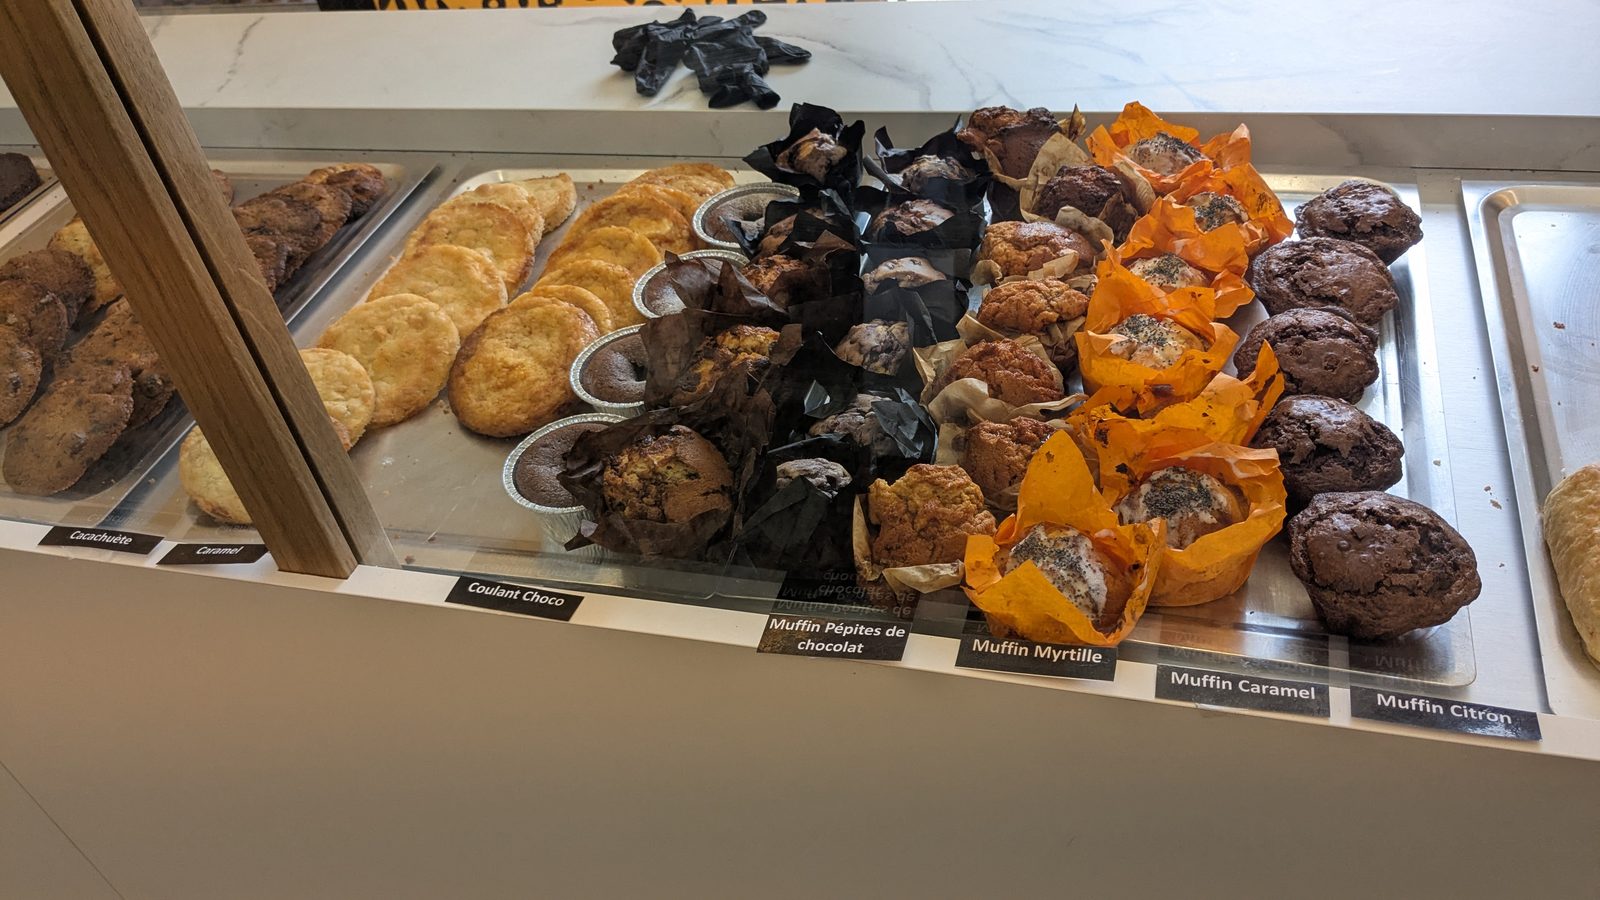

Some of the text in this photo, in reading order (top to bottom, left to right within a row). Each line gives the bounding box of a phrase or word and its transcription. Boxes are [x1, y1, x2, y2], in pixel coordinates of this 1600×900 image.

[69, 530, 133, 545] Cacachuète
[195, 545, 245, 555] Caramel
[467, 582, 565, 607] Coulant Choco
[769, 618, 906, 638] Muffin Pépites de
[797, 638, 865, 654] chocolat
[972, 638, 1103, 664] Muffin Myrtille
[1171, 671, 1316, 700] Muffin Caramel
[1376, 693, 1512, 725] Muffin Citron
